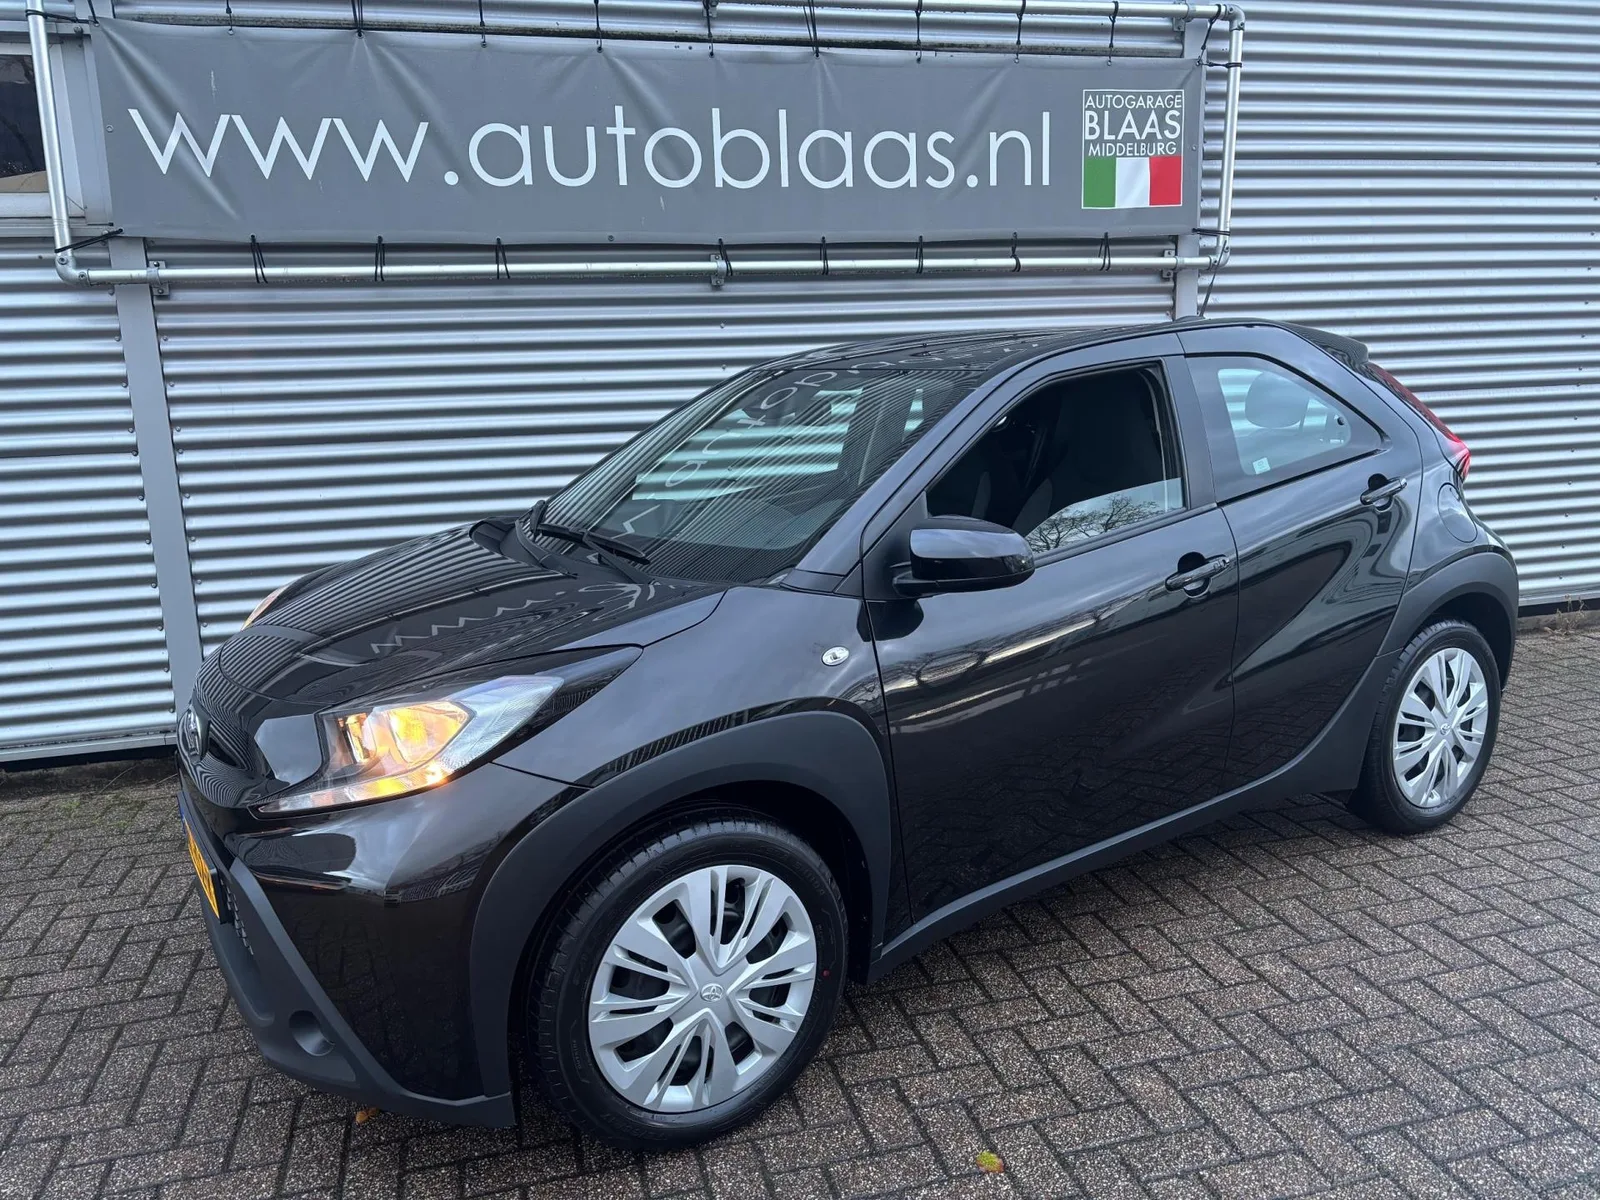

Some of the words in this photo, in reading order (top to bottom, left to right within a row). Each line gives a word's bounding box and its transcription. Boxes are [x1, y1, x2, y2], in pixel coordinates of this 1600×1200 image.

[1085, 94, 1181, 108] AUTOGARAGE
[1085, 110, 1180, 140] BLAAS
[128, 106, 1050, 188] www.autoblaas.nl
[1088, 142, 1177, 156] MIDDELBURG
